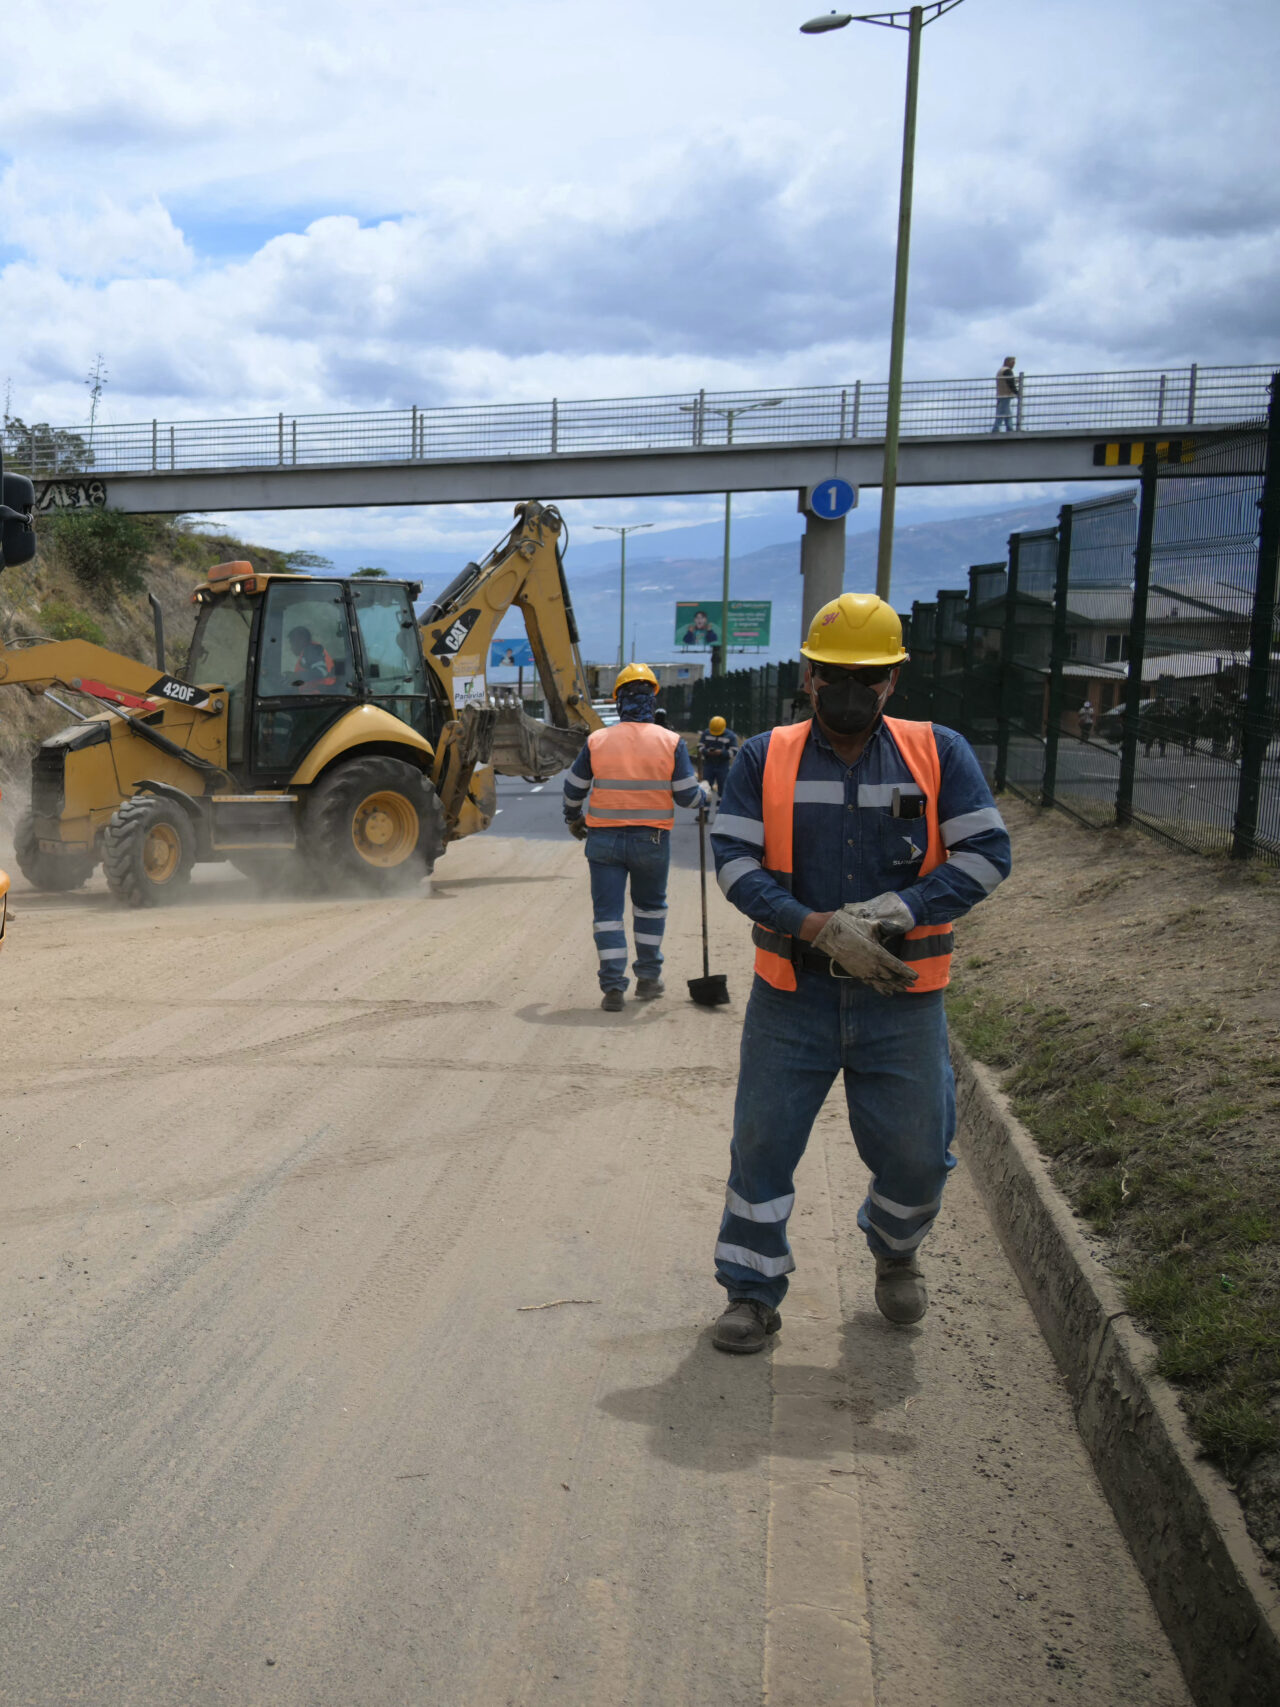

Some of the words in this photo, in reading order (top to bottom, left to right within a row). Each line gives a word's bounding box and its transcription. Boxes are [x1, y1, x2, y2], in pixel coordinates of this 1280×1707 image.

[827, 486, 837, 511] 1
[445, 619, 468, 651] CAT
[162, 682, 195, 702] 420F
